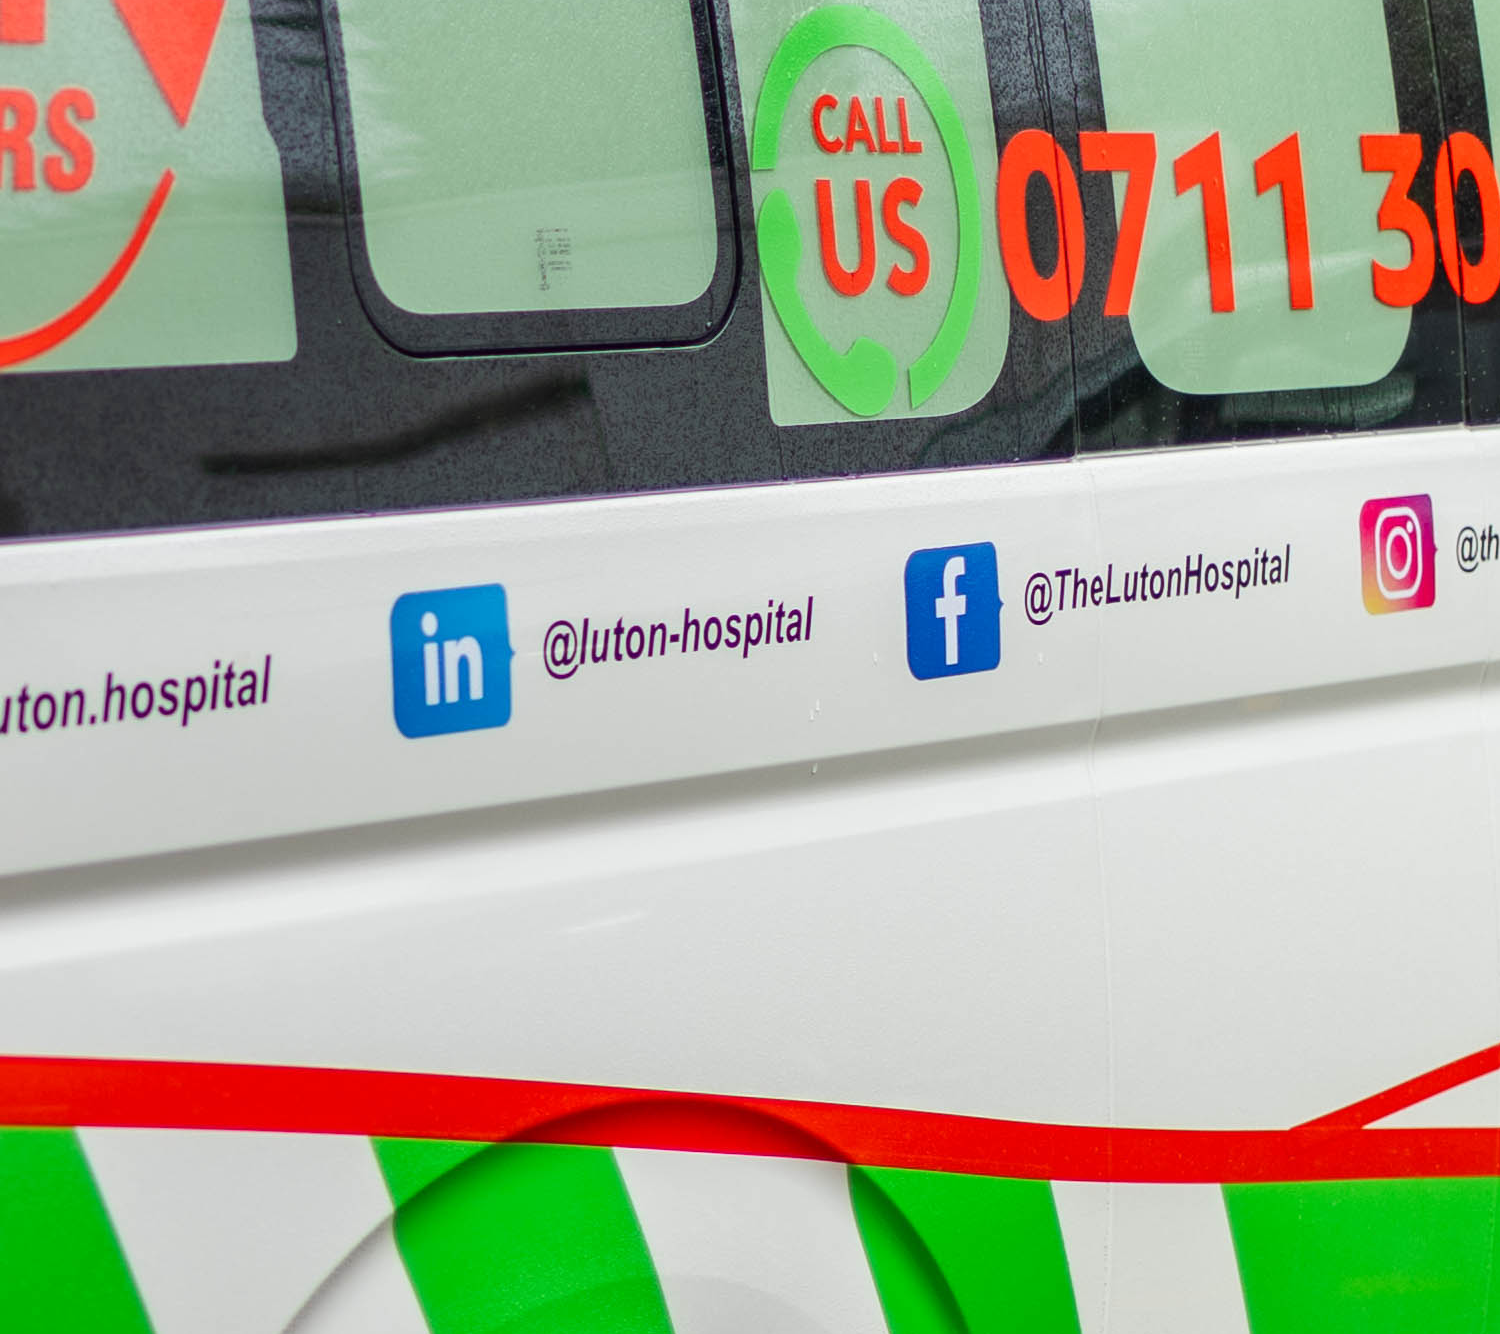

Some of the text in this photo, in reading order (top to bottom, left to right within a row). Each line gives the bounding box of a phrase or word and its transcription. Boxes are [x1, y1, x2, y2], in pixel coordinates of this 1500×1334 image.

[811, 93, 924, 155] CALL
[815, 176, 932, 298] US
[996, 128, 1316, 323] 0711
[1024, 543, 1292, 627] @TheLutonHospital
[542, 595, 815, 681] @luton-hospital
